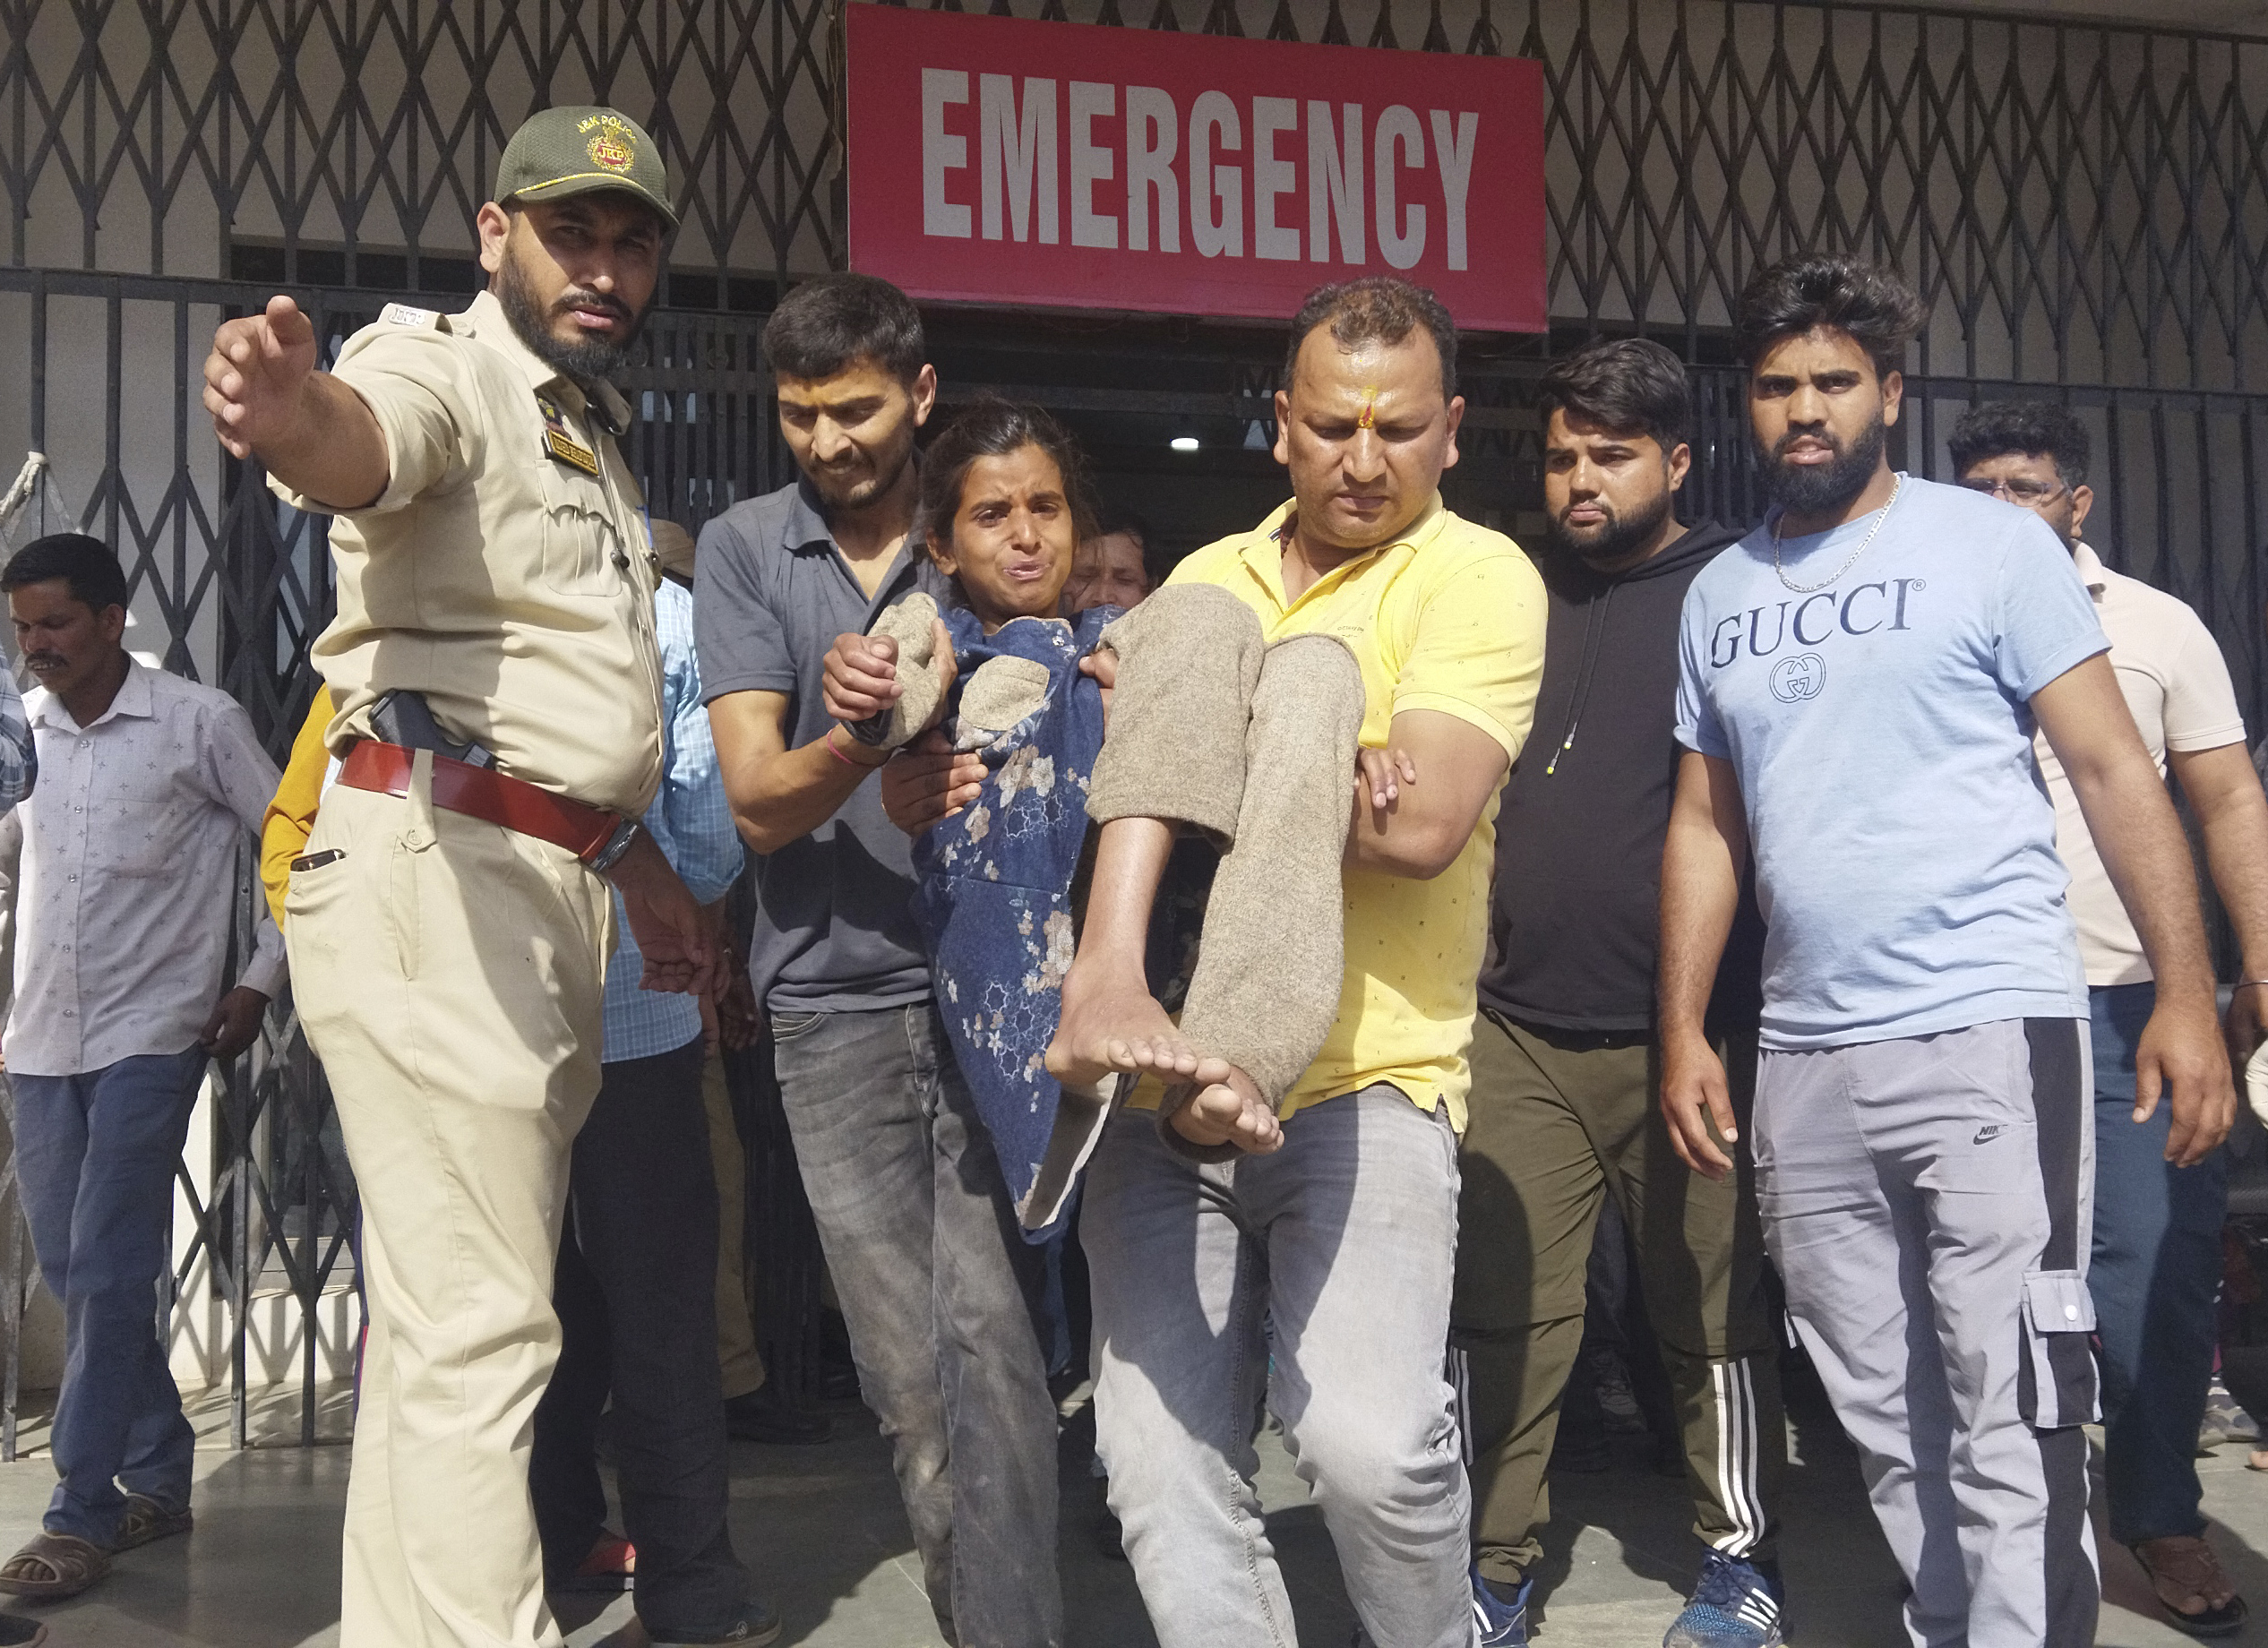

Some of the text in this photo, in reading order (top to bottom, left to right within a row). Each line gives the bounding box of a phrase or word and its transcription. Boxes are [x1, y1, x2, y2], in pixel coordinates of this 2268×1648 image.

[576, 115, 600, 133] J&K
[597, 146, 625, 161] JKP
[921, 67, 1479, 271] EMERGENCY
[1978, 1124, 2008, 1137] NIK
